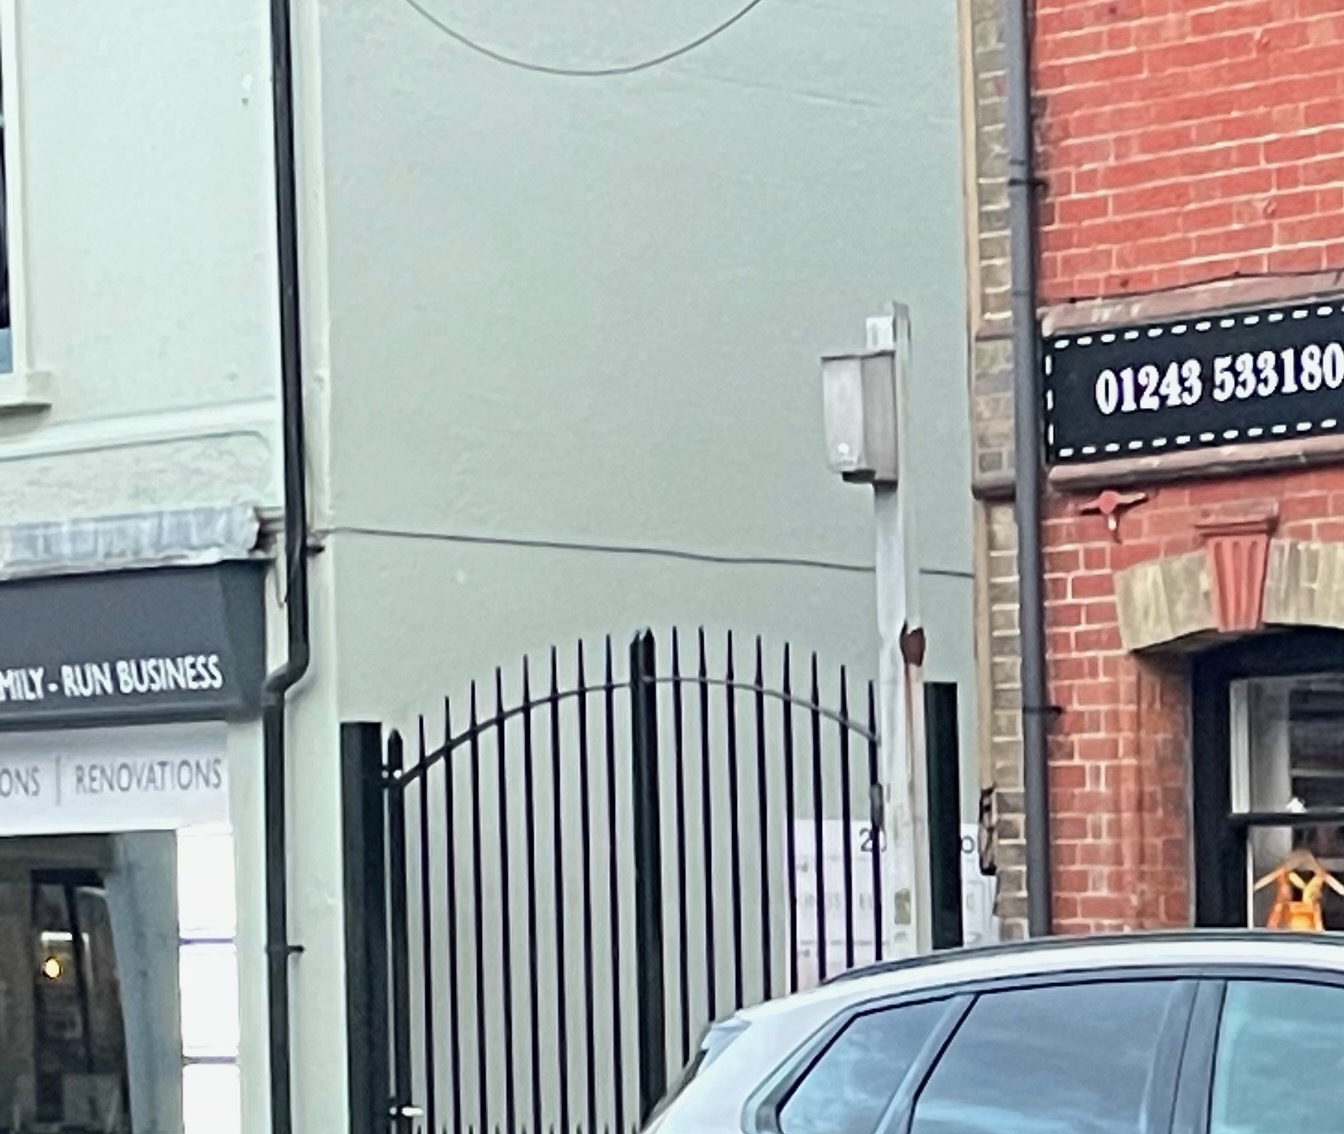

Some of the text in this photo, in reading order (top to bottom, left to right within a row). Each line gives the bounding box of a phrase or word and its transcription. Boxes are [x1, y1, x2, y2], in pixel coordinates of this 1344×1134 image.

[1095, 358, 1203, 415] 01243
[61, 663, 113, 698] RUN
[116, 654, 223, 694] BUSINESS
[75, 757, 222, 794] RENOVATIONS
